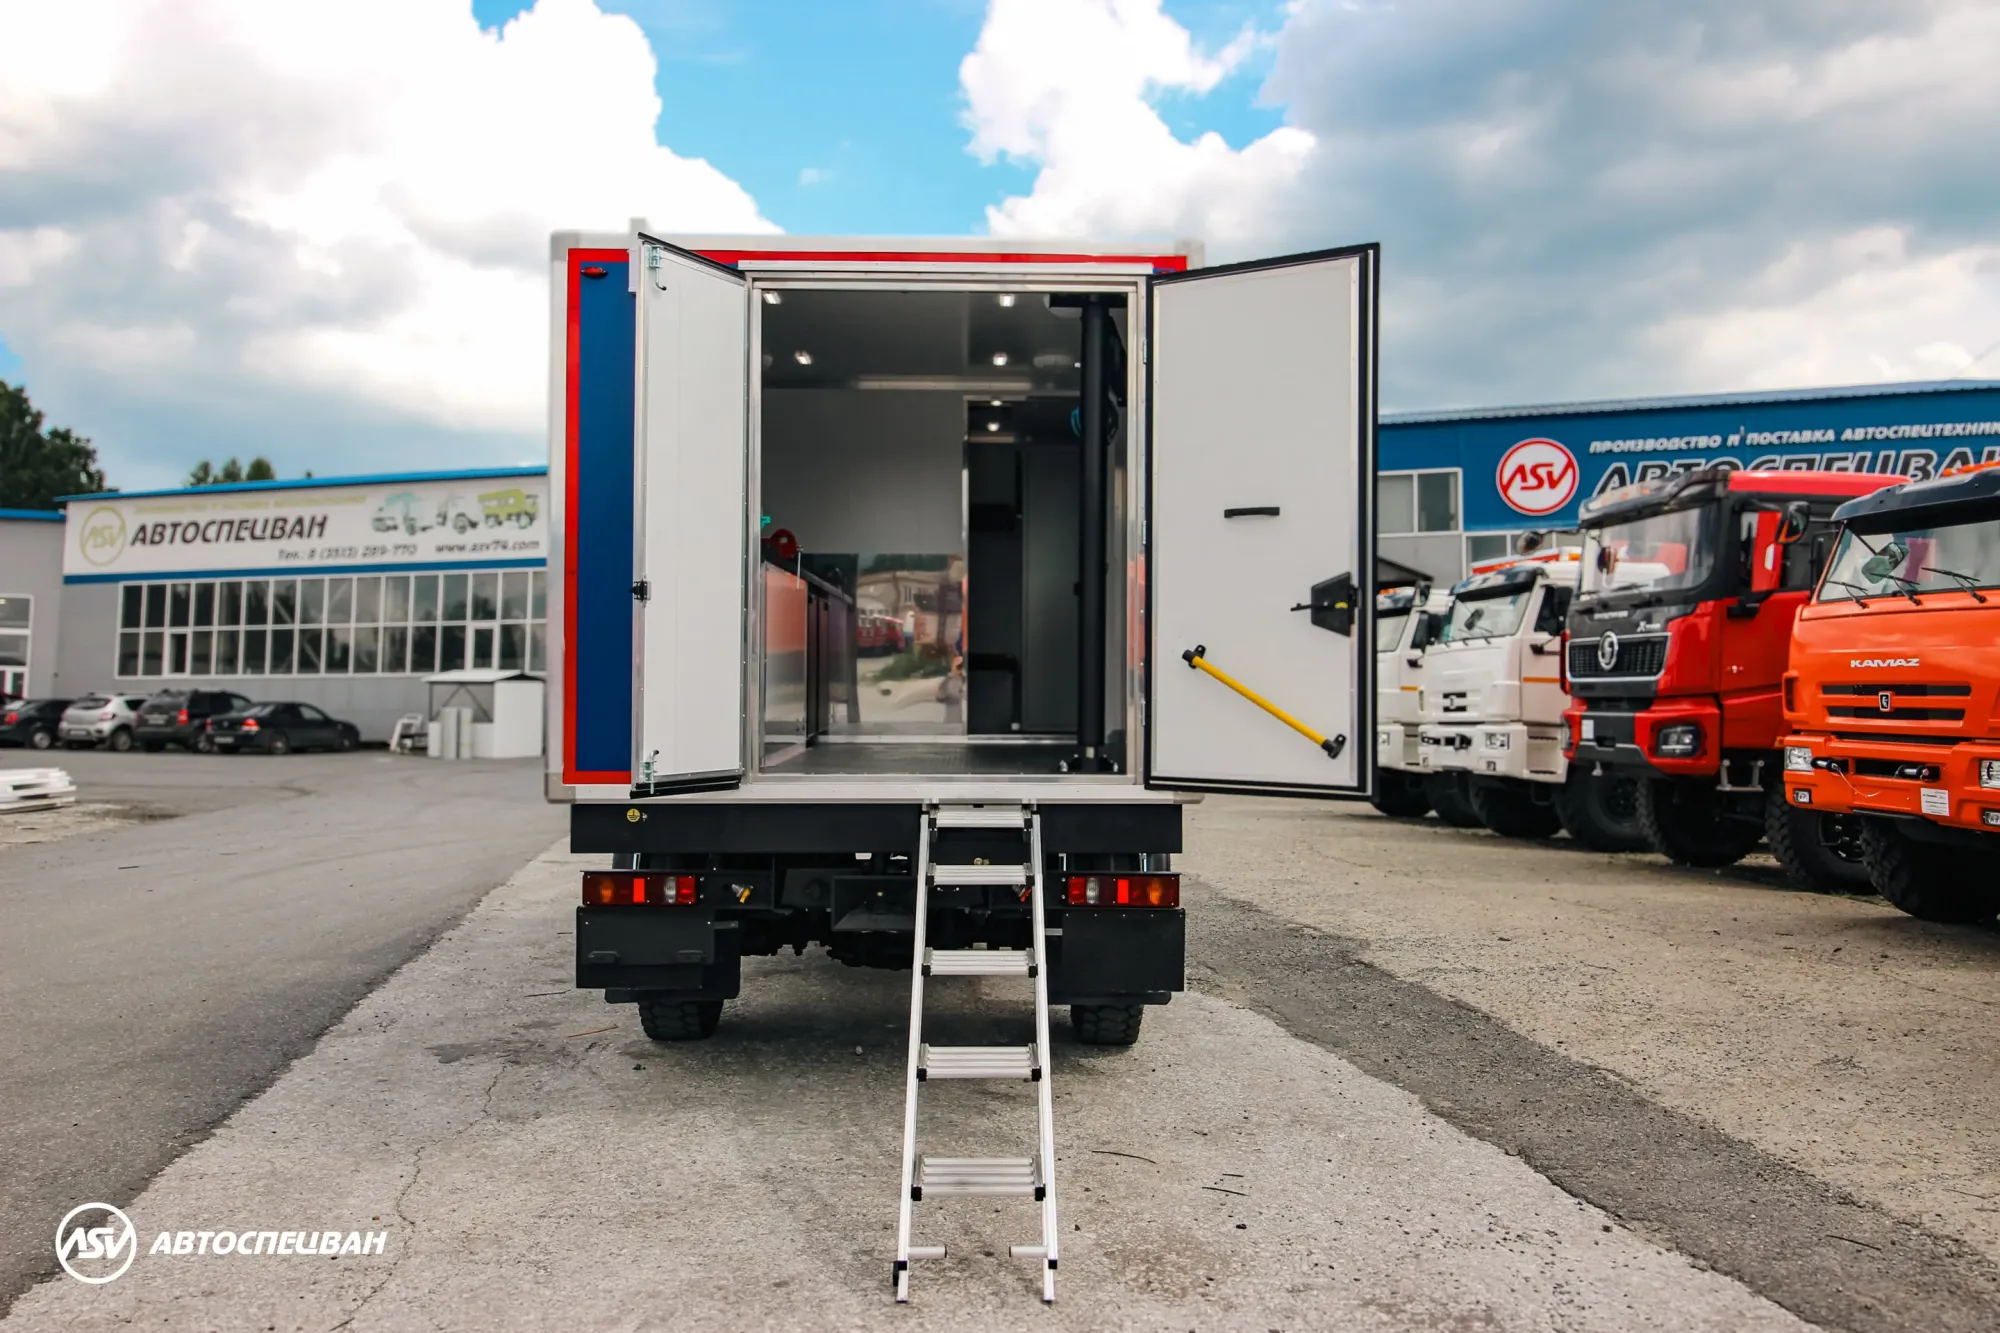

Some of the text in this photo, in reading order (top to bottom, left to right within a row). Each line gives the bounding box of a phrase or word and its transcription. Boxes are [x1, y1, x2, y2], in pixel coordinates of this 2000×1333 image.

[1588, 434, 1723, 454] ПРОИЗВОДСТВО
[1726, 433, 1741, 447] И
[1745, 429, 1835, 446] ПОСТАВКА
[131, 514, 328, 547] АВТОСПЕЦВАН
[1850, 658, 1920, 668] KAMAZ
